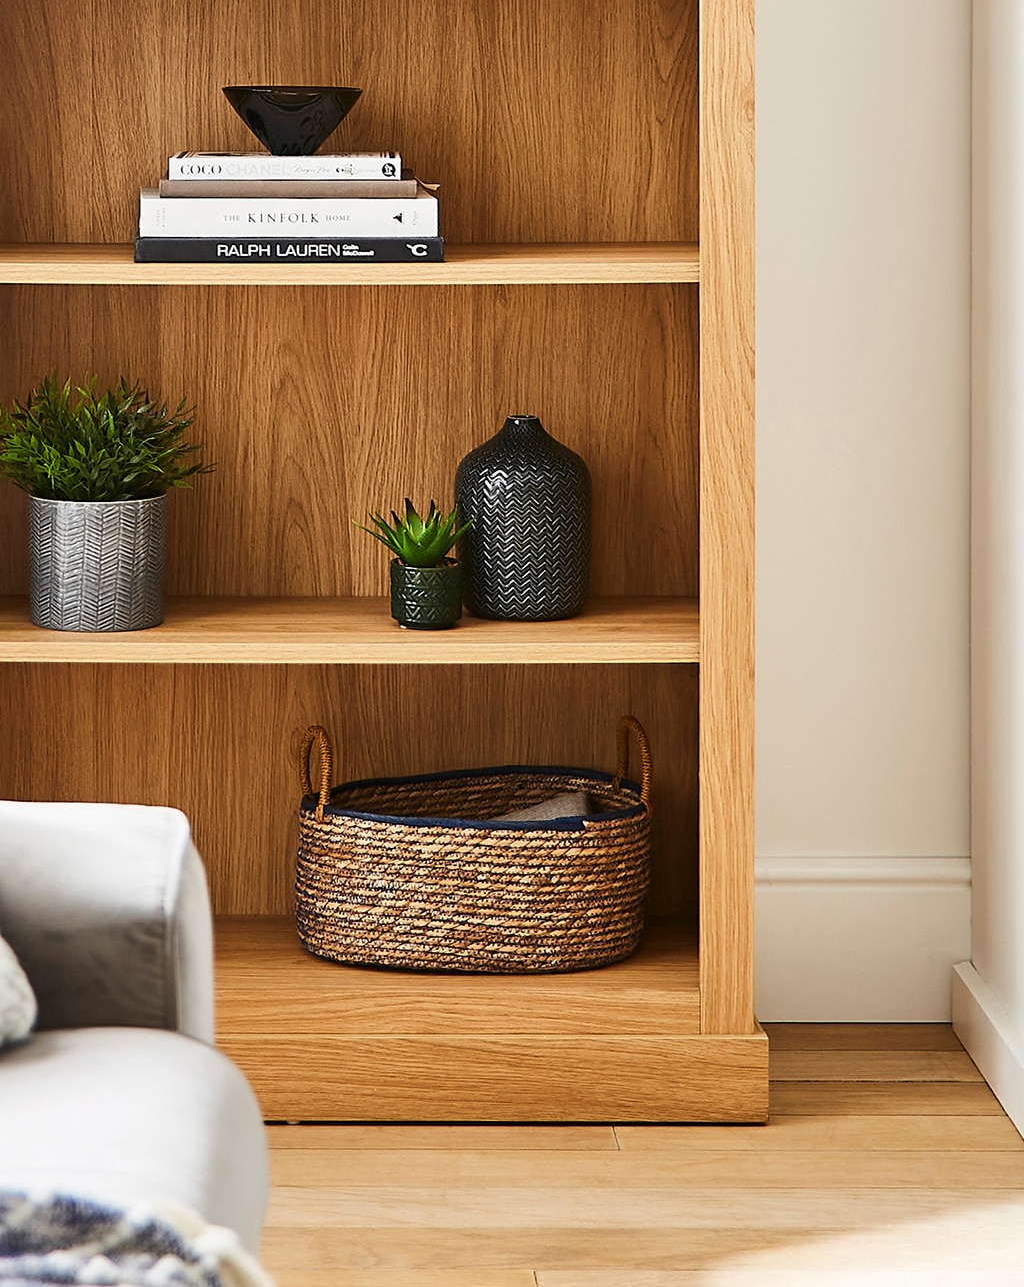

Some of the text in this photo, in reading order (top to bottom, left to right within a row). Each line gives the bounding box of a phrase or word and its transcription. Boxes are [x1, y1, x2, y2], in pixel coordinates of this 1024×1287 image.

[180, 163, 222, 176] COCO
[226, 163, 291, 176] CHANEL
[223, 212, 352, 224] THE KINFOLK HOME
[216, 243, 341, 257] RALPH LAUREN
